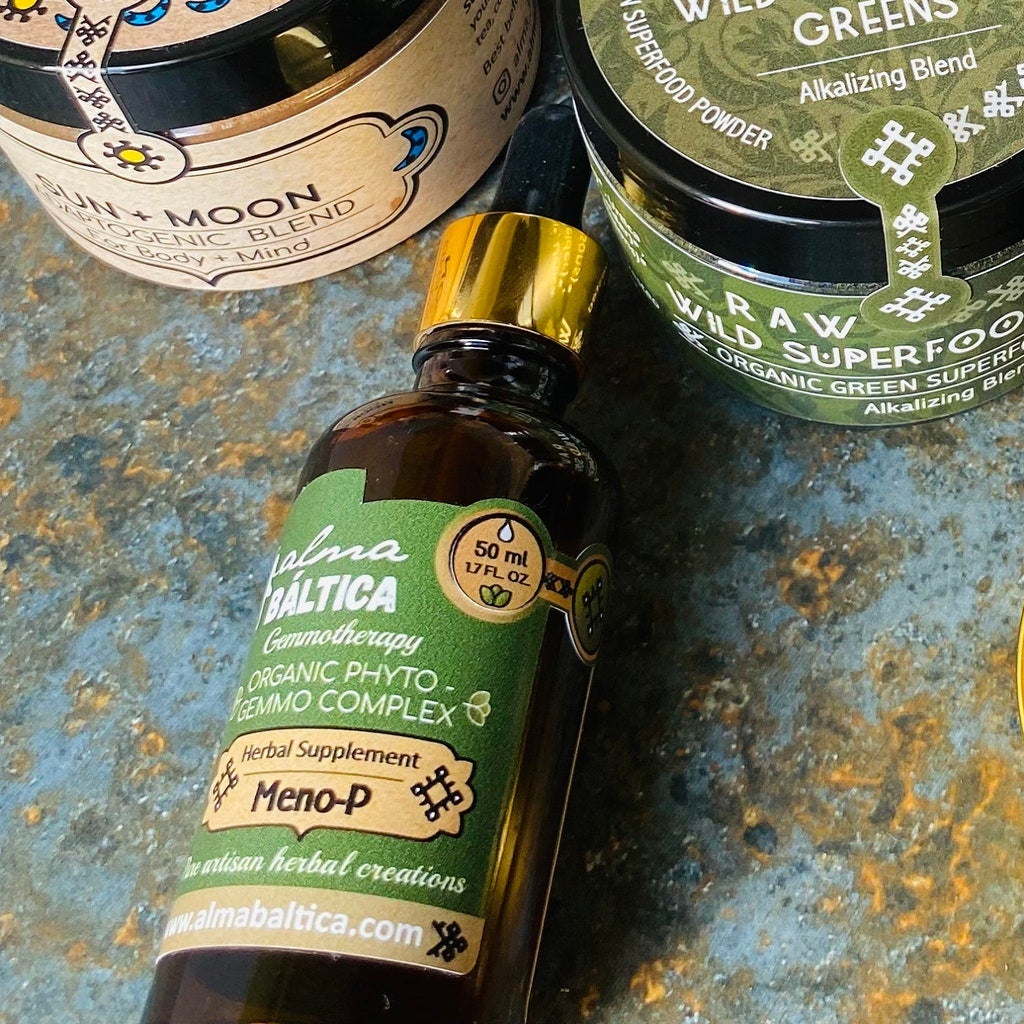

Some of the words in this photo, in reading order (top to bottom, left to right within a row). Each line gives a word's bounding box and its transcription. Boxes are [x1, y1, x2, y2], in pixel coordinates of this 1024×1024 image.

[622, 4, 696, 111] SUPERFOOD
[688, 97, 774, 150] POWDER
[799, 63, 907, 104] Alkalizing
[912, 48, 977, 83] Blend
[36, 173, 119, 223] SUN
[164, 183, 322, 230] MOON
[248, 198, 355, 244] BLEND
[137, 245, 206, 268] Body
[238, 239, 310, 263] Mind
[664, 282, 763, 351] WILD
[725, 290, 861, 339] RAW
[864, 385, 975, 417] Alkalizing
[280, 524, 409, 574] alma
[474, 539, 500, 559] 50
[504, 549, 528, 567] ml
[264, 568, 398, 626] BÁLTICA
[263, 620, 423, 656] Gemmotherapy
[248, 660, 338, 692] ORGANIC
[344, 661, 439, 693] PHYTO
[236, 690, 313, 723] GEMMO
[318, 691, 457, 727] COMPLEX
[242, 741, 292, 764] Herbal
[296, 740, 422, 769] Supplement
[250, 780, 373, 817] Meno-P
